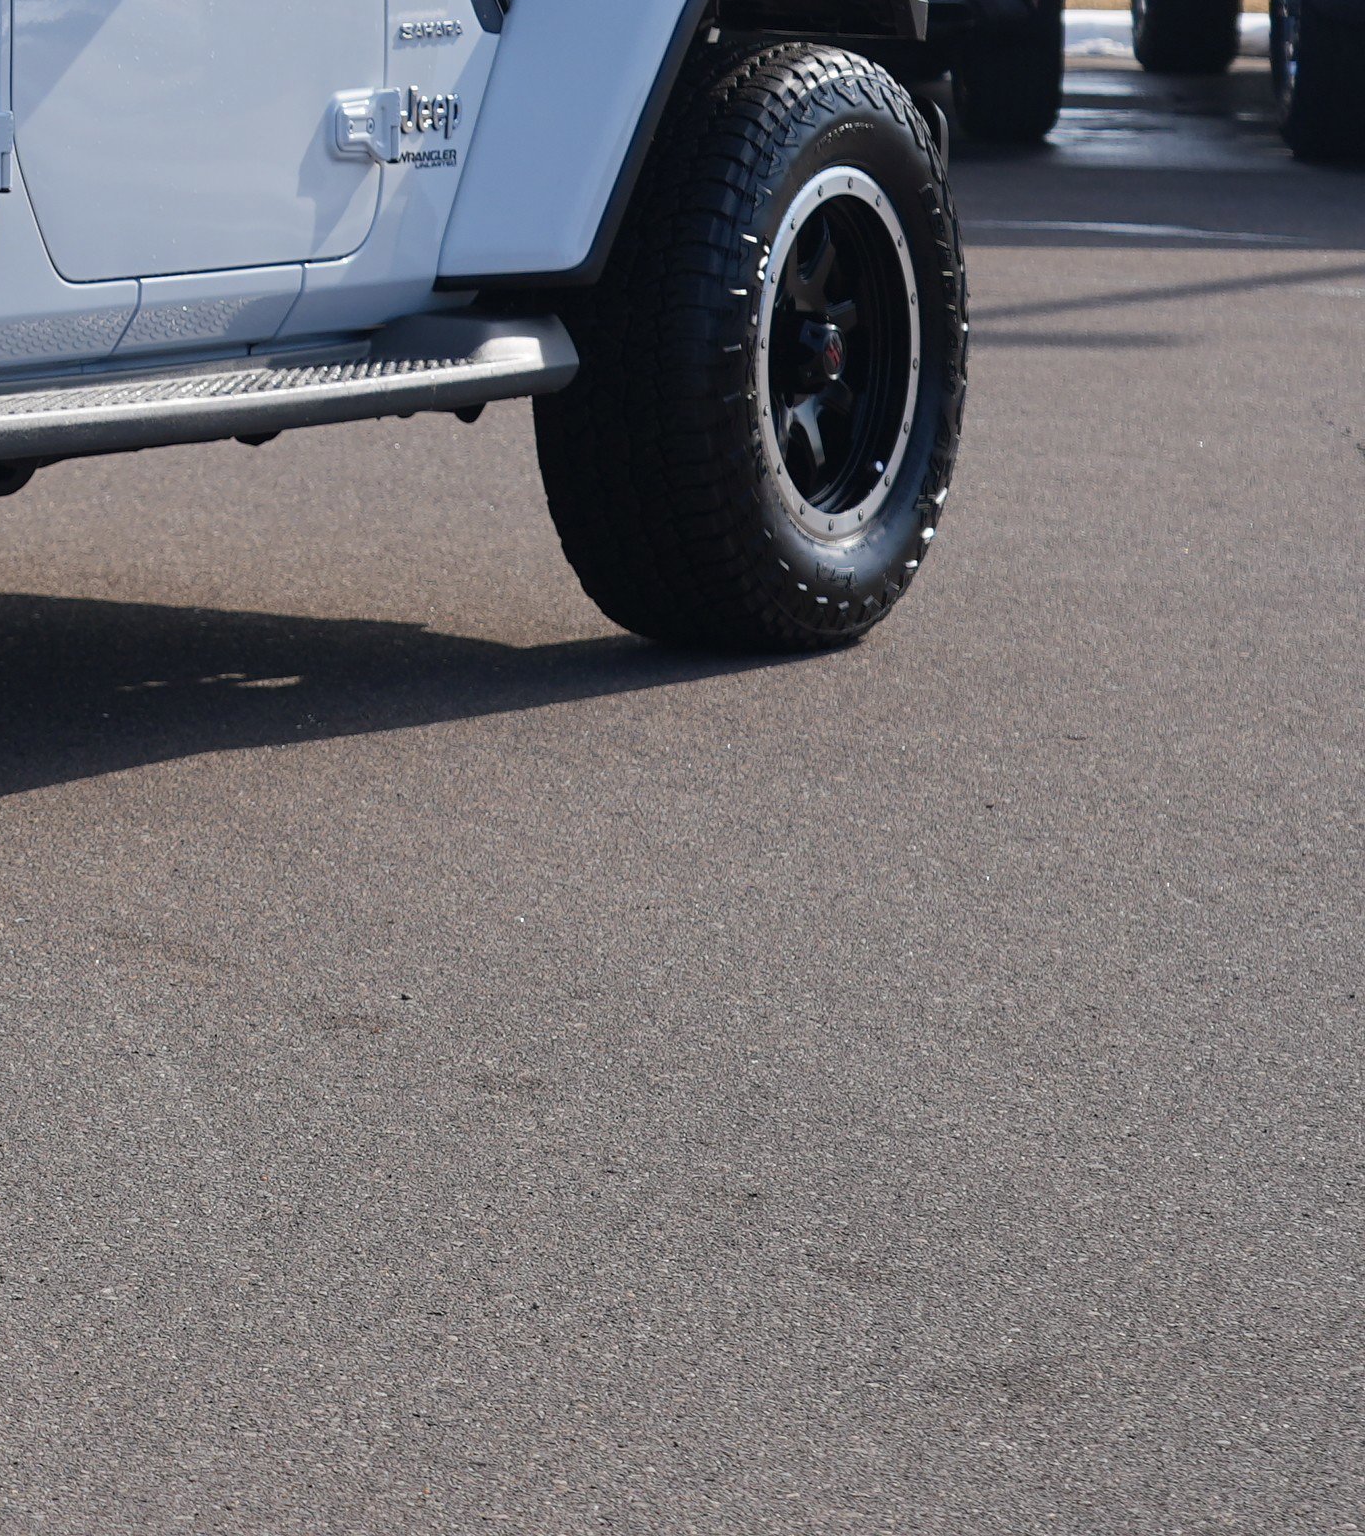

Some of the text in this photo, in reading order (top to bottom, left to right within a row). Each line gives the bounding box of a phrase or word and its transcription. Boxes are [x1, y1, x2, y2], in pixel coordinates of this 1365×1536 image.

[400, 20, 463, 40] SAHARA
[400, 84, 462, 140] Jeep
[397, 149, 457, 164] WRANGLER
